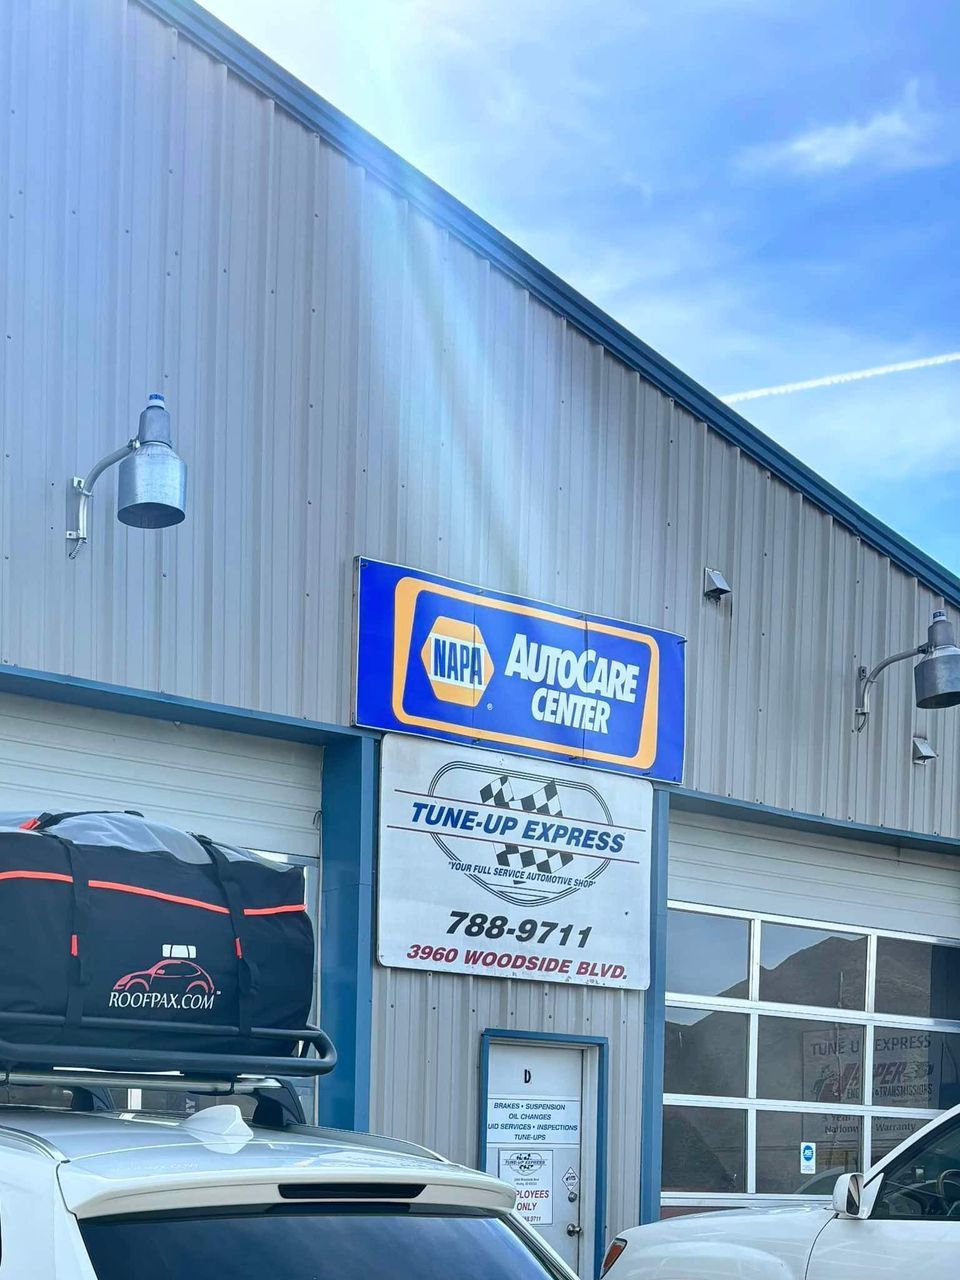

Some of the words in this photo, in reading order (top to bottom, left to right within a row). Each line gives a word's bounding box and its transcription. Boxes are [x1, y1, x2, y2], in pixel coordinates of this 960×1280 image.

[433, 637, 483, 686] NAPA
[531, 687, 611, 734] CENTER
[411, 801, 518, 836] TUNE-UP
[522, 820, 626, 854] EXPRESS
[473, 864, 492, 875] FULL
[493, 867, 525, 880] SERVICE
[526, 871, 573, 886] AUTOMOTIVE
[445, 910, 593, 949] 788-9711
[406, 944, 459, 963] 3960
[464, 949, 573, 974] WOODSIDE
[576, 961, 628, 980] BLVD.
[108, 991, 215, 1010] ROOFPAX.COM
[851, 1039, 860, 1053] U
[523, 1068, 532, 1084] D
[493, 1102, 520, 1110] BRAKES
[525, 1103, 566, 1111] SUSPENSION
[520, 1113, 552, 1121] CHANGES
[500, 1123, 532, 1131] SERVICES
[536, 1124, 578, 1132] INSPECTIONS
[516, 1190, 550, 1199] PLOYEES
[516, 1202, 538, 1211] ONLY
